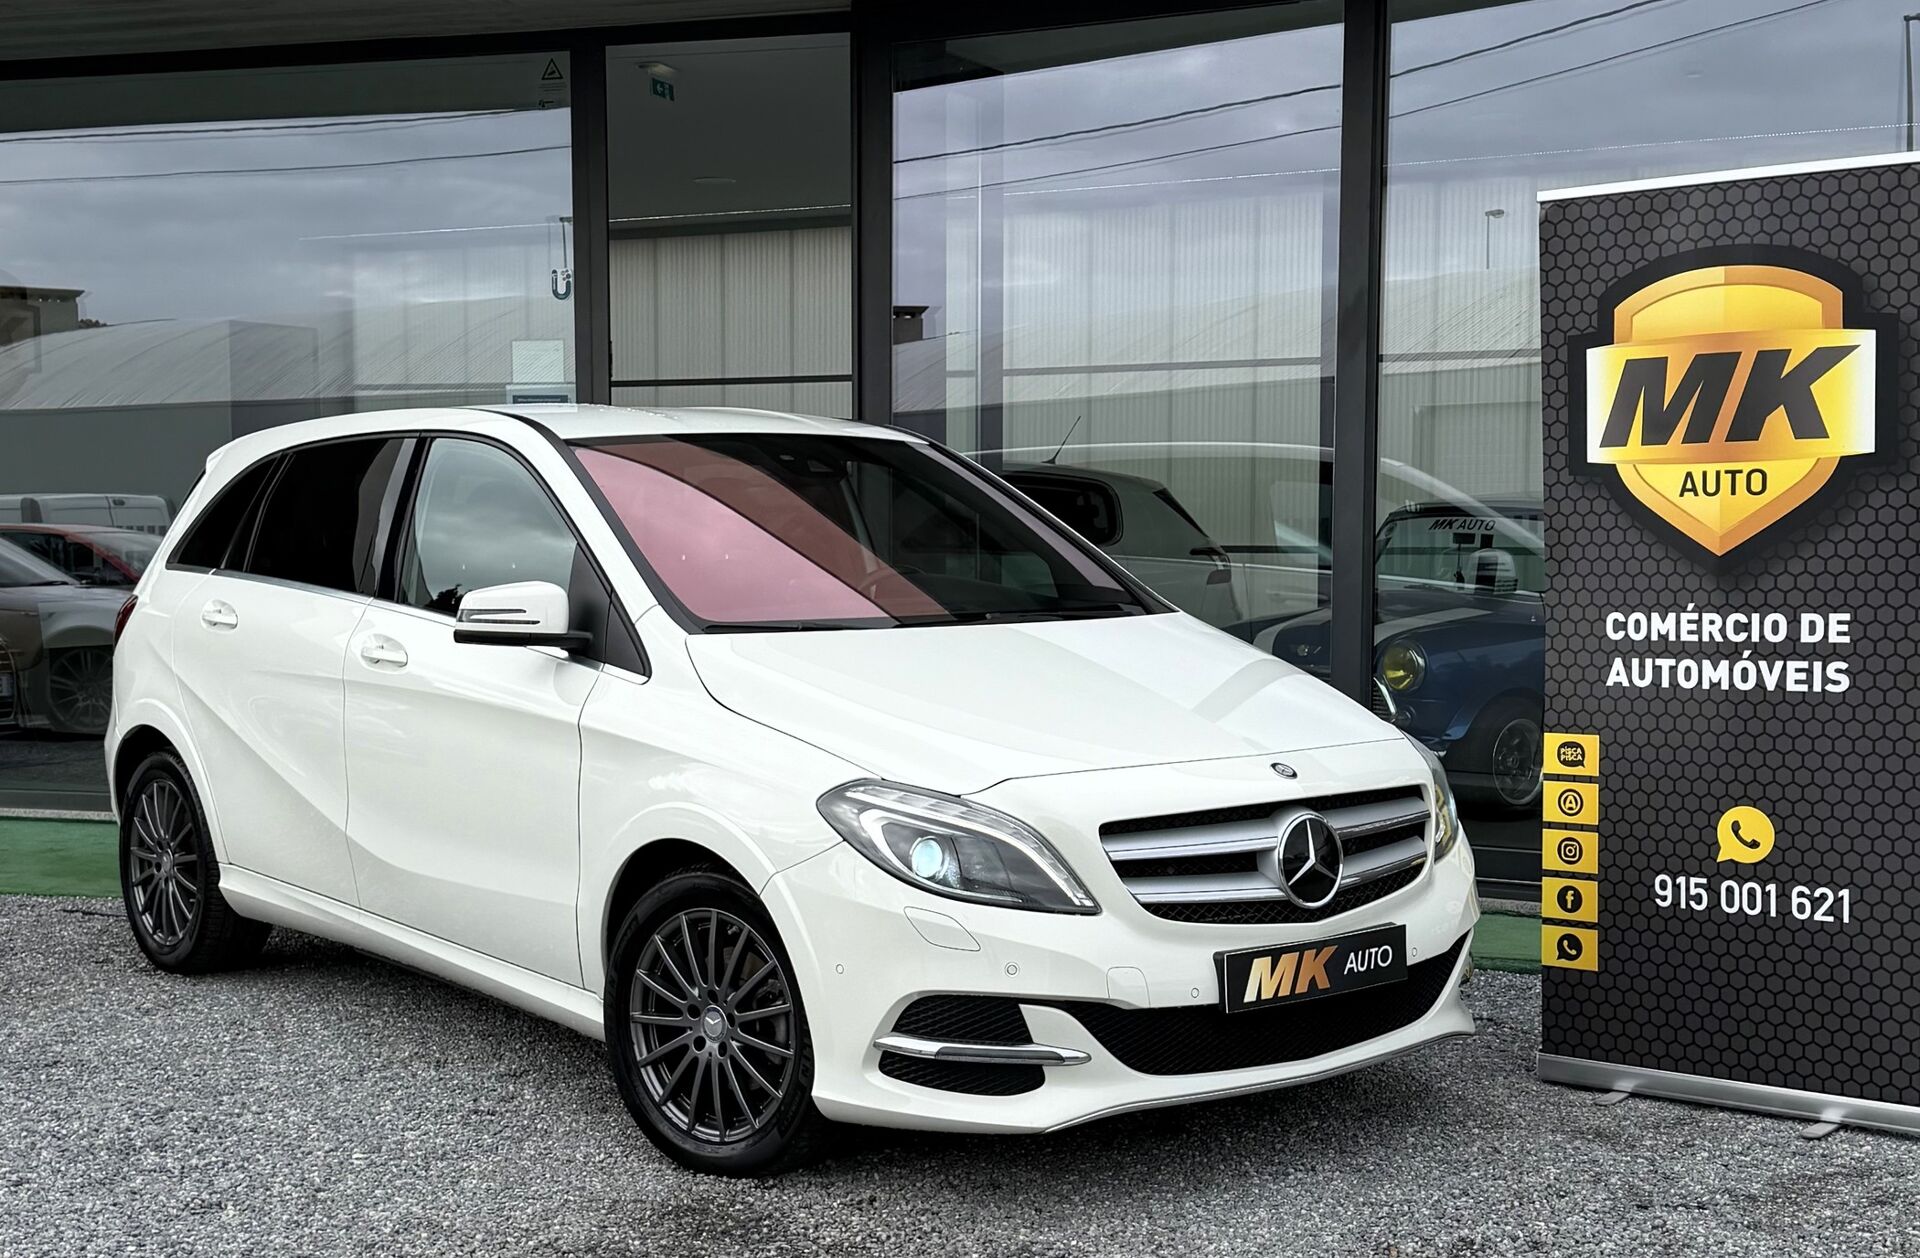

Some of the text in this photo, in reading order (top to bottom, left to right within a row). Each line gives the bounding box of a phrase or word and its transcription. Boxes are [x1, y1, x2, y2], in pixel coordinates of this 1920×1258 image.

[1600, 345, 1861, 447] MK
[1679, 468, 1768, 497] AUTO
[1429, 518, 1496, 531] MK AUTO
[1606, 603, 1851, 643] COMÉRCIO DE
[1606, 650, 1851, 693] AUTOMÓVEIS
[1654, 874, 1850, 924] 915 001 621
[1243, 945, 1393, 1003] MK AUTO
